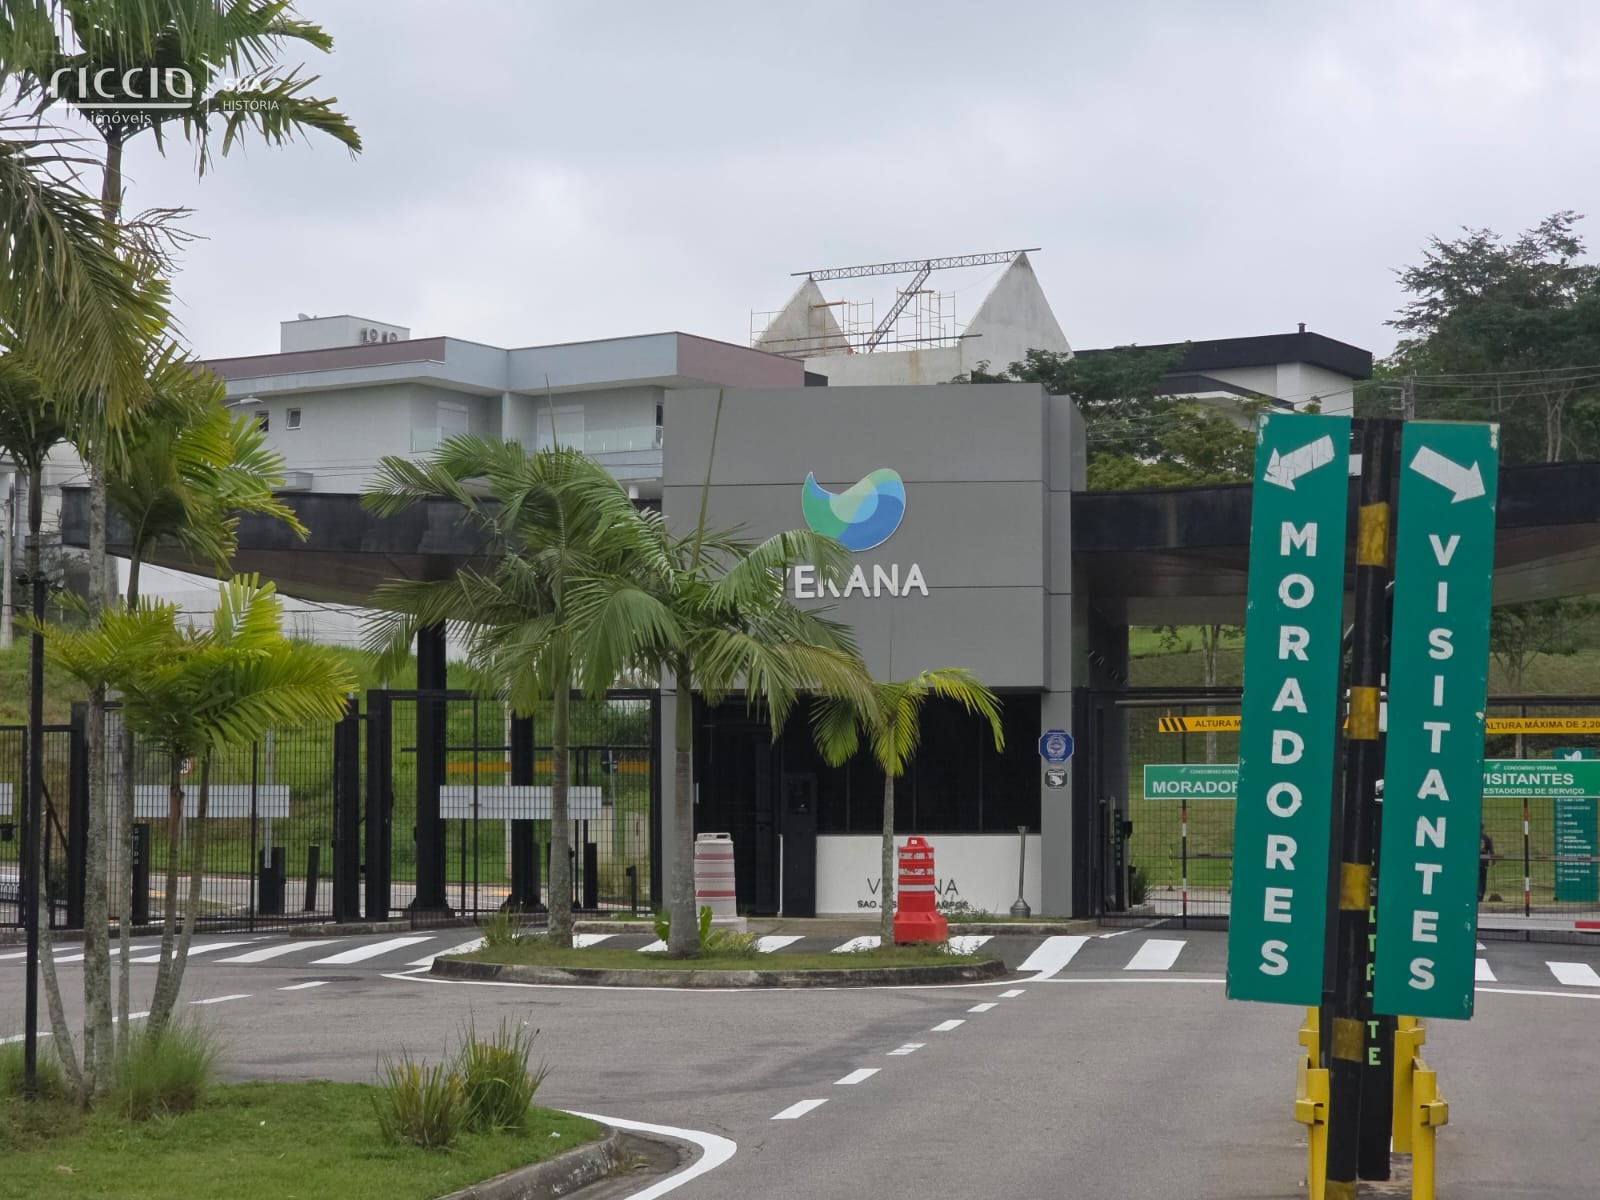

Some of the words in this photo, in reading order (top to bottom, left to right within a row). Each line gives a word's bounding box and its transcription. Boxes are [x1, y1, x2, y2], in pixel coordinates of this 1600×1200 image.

[1195, 719, 1232, 728] ALTURA
[1485, 720, 1522, 730] ALTURA
[1524, 720, 1563, 729] MÁXIMA
[1565, 720, 1579, 729] DE
[1258, 521, 1318, 977] MORADORES
[1408, 534, 1461, 991] VISITANTES
[1535, 787, 1547, 795] DE
[1548, 787, 1585, 796] SERVIÇO
